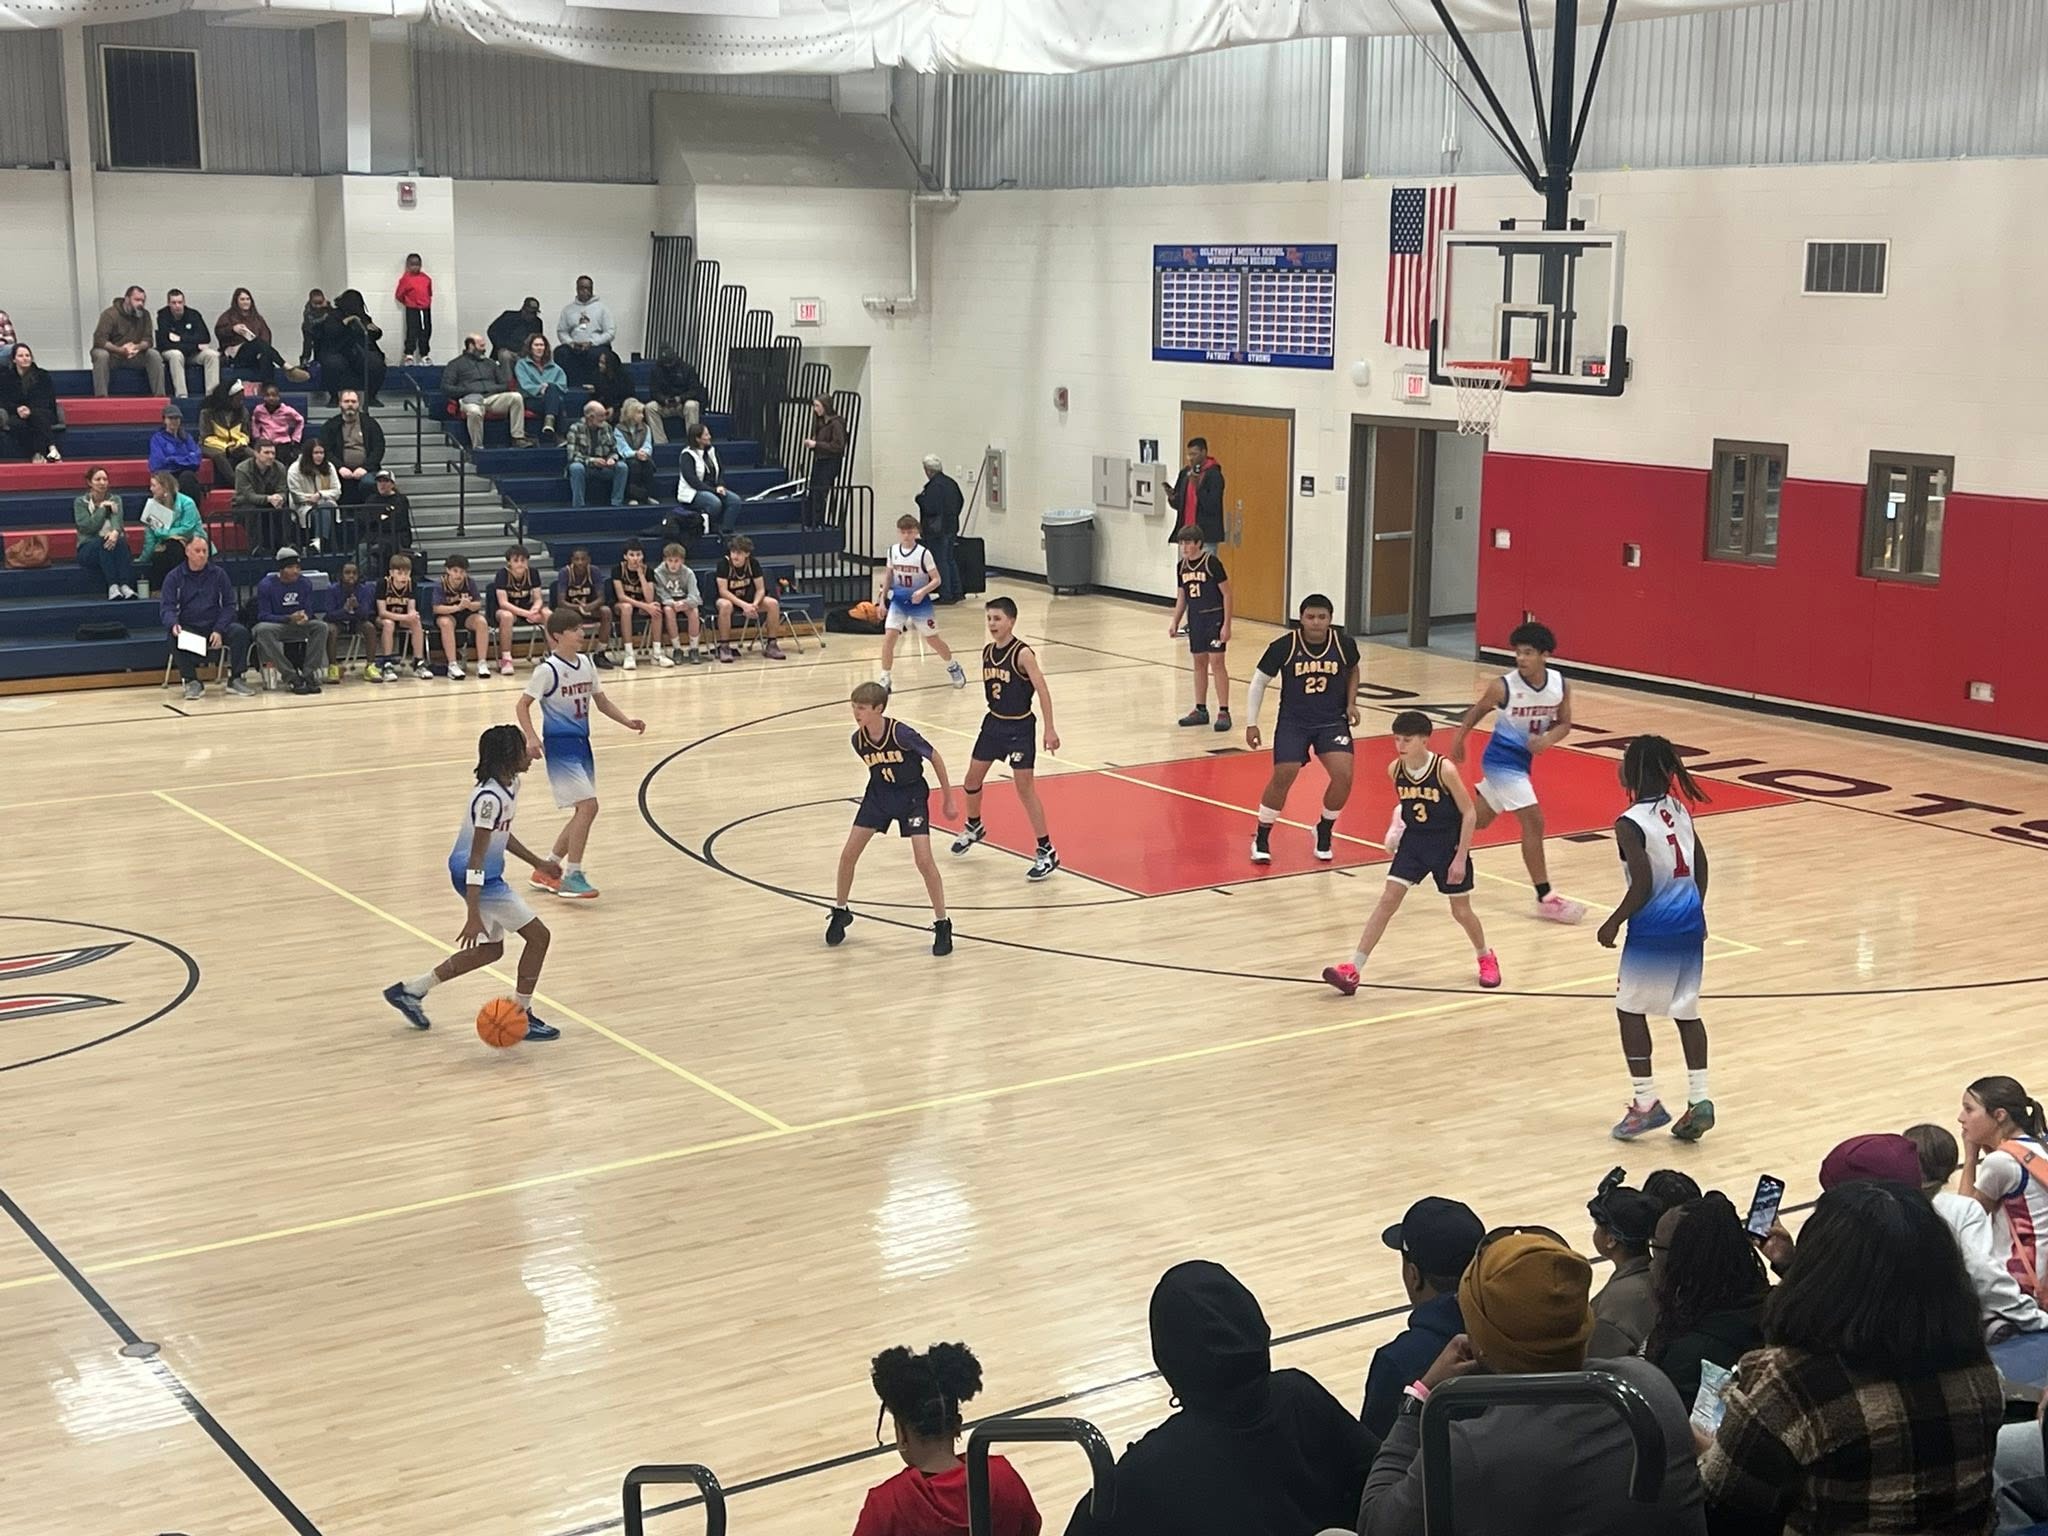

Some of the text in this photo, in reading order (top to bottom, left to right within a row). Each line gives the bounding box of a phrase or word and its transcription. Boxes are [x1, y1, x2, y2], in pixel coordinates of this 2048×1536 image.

[1262, 247, 1285, 257] SCHOOL
[801, 303, 816, 320] EXIT
[1206, 351, 1231, 361] PATRIOT
[1408, 376, 1423, 394] EXIT
[898, 575, 913, 588] 10
[1189, 583, 1201, 598] 21
[1294, 660, 1339, 678] EAGLES
[991, 682, 1002, 700] 2
[1304, 676, 1328, 694] 23
[1398, 785, 1441, 803] EAGLES
[1412, 802, 1428, 823] 3
[1666, 833, 1691, 879] 1
